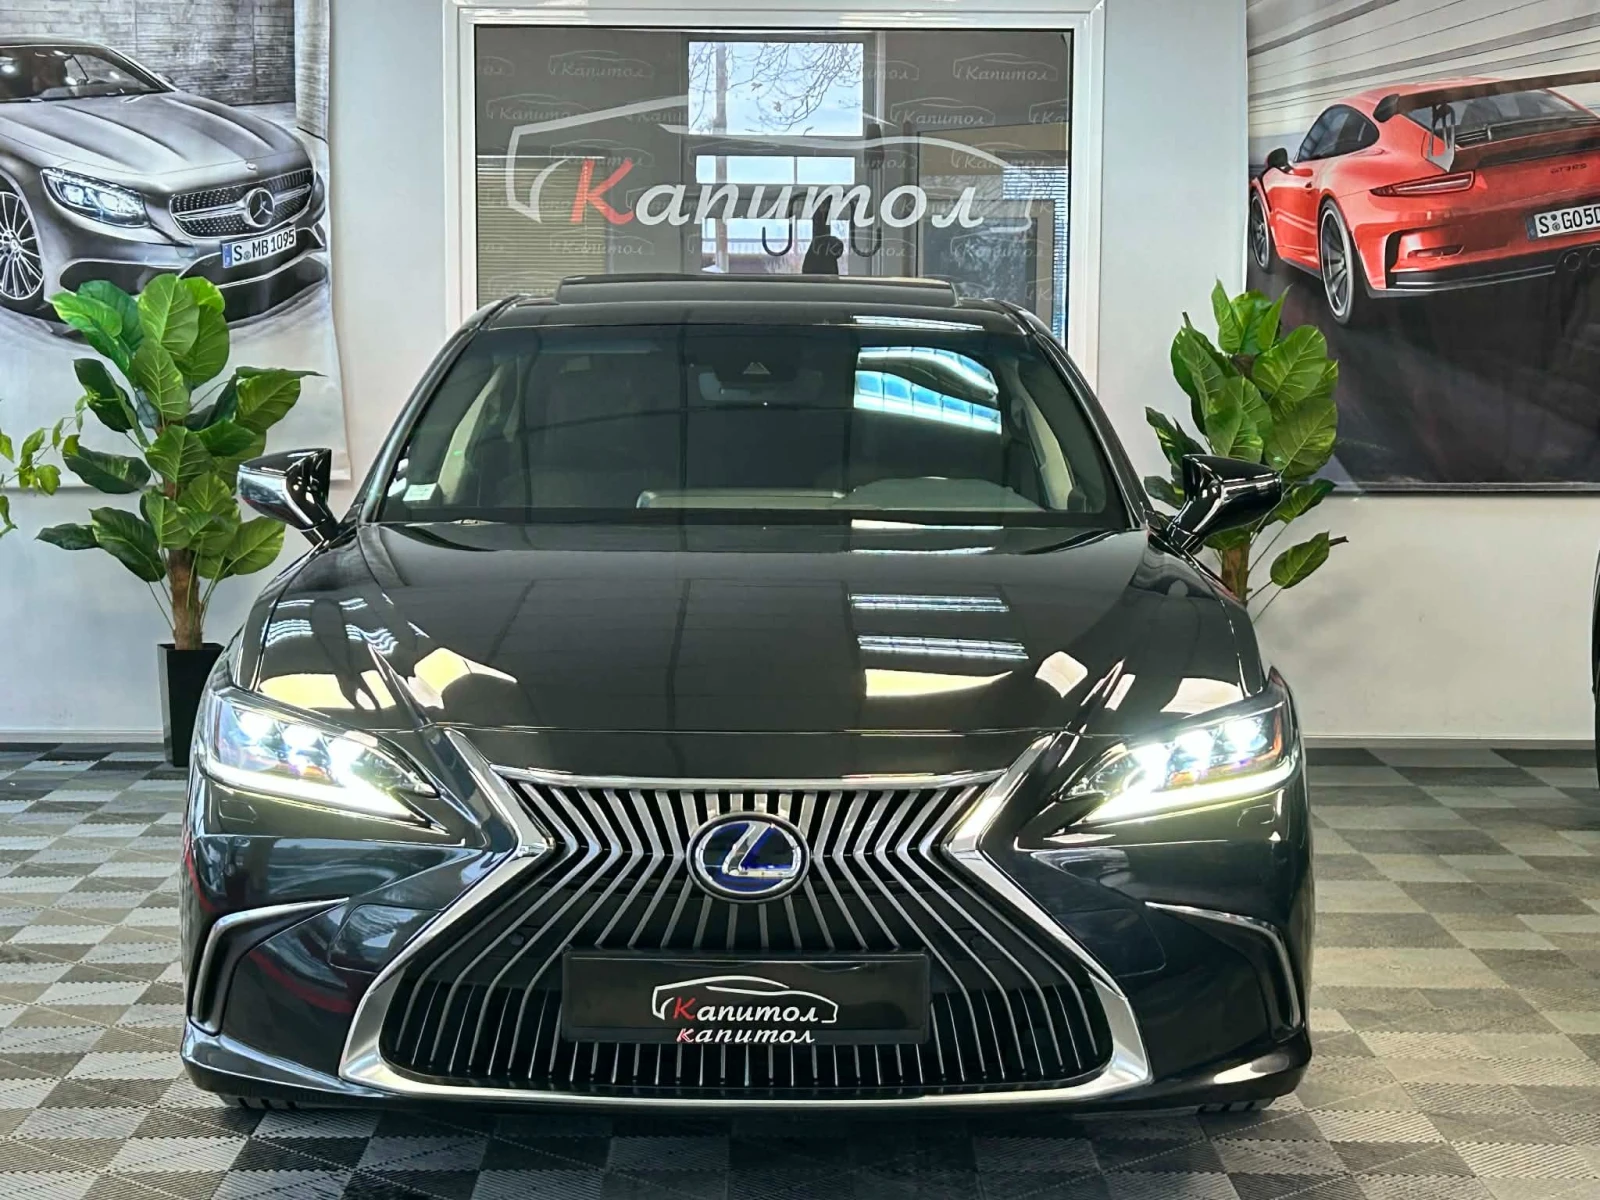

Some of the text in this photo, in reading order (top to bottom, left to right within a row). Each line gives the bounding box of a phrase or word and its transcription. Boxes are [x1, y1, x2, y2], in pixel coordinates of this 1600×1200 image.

[964, 67, 1049, 81] Капитол
[901, 109, 985, 125] Капитол
[570, 157, 984, 228] Капитол
[673, 996, 819, 1022] Капитол
